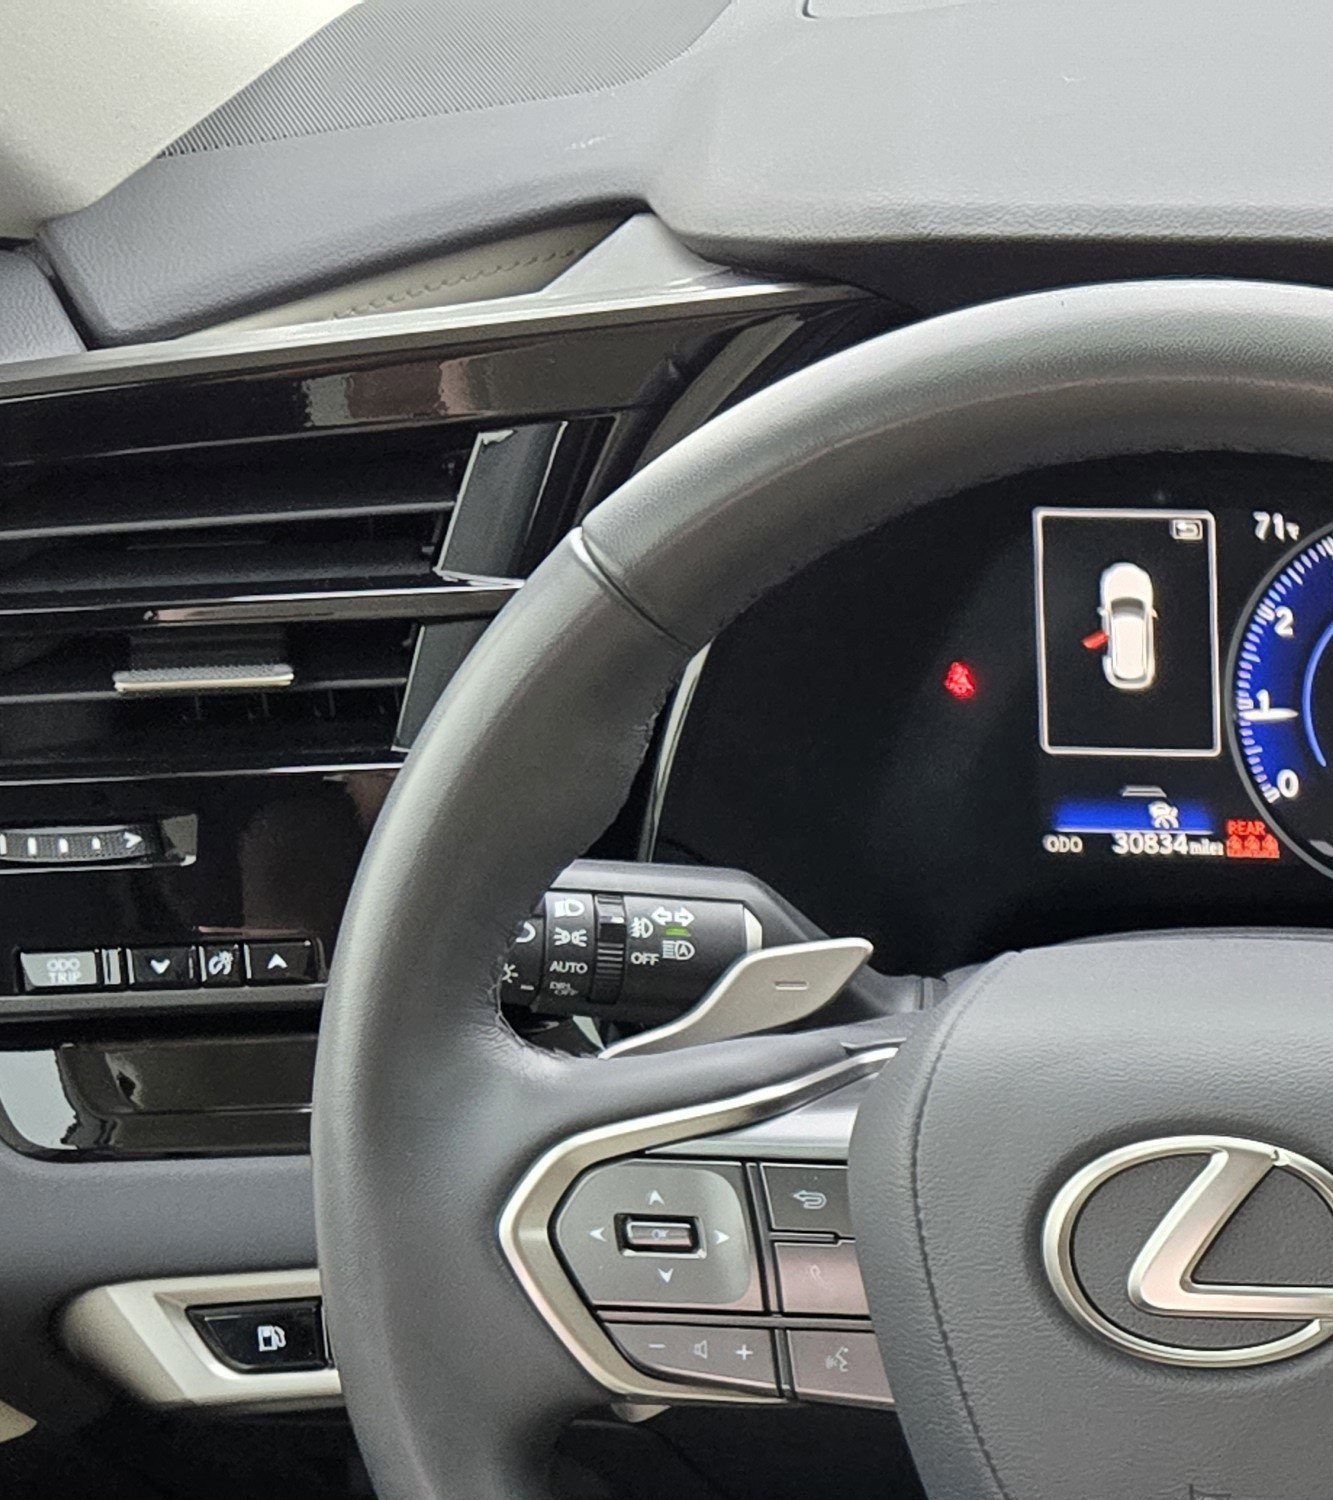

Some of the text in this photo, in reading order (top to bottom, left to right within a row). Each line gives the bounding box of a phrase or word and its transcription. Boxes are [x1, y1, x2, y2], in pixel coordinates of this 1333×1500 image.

[1275, 607, 1293, 637] 2
[1277, 769, 1299, 798] 0
[1226, 820, 1266, 835] REAR
[1043, 834, 1083, 853] ODO
[1111, 832, 1189, 855] 30834
[47, 958, 80, 971] ODO
[631, 952, 659, 966] OFF
[550, 961, 588, 974] AUTO
[48, 970, 82, 983] TRIP
